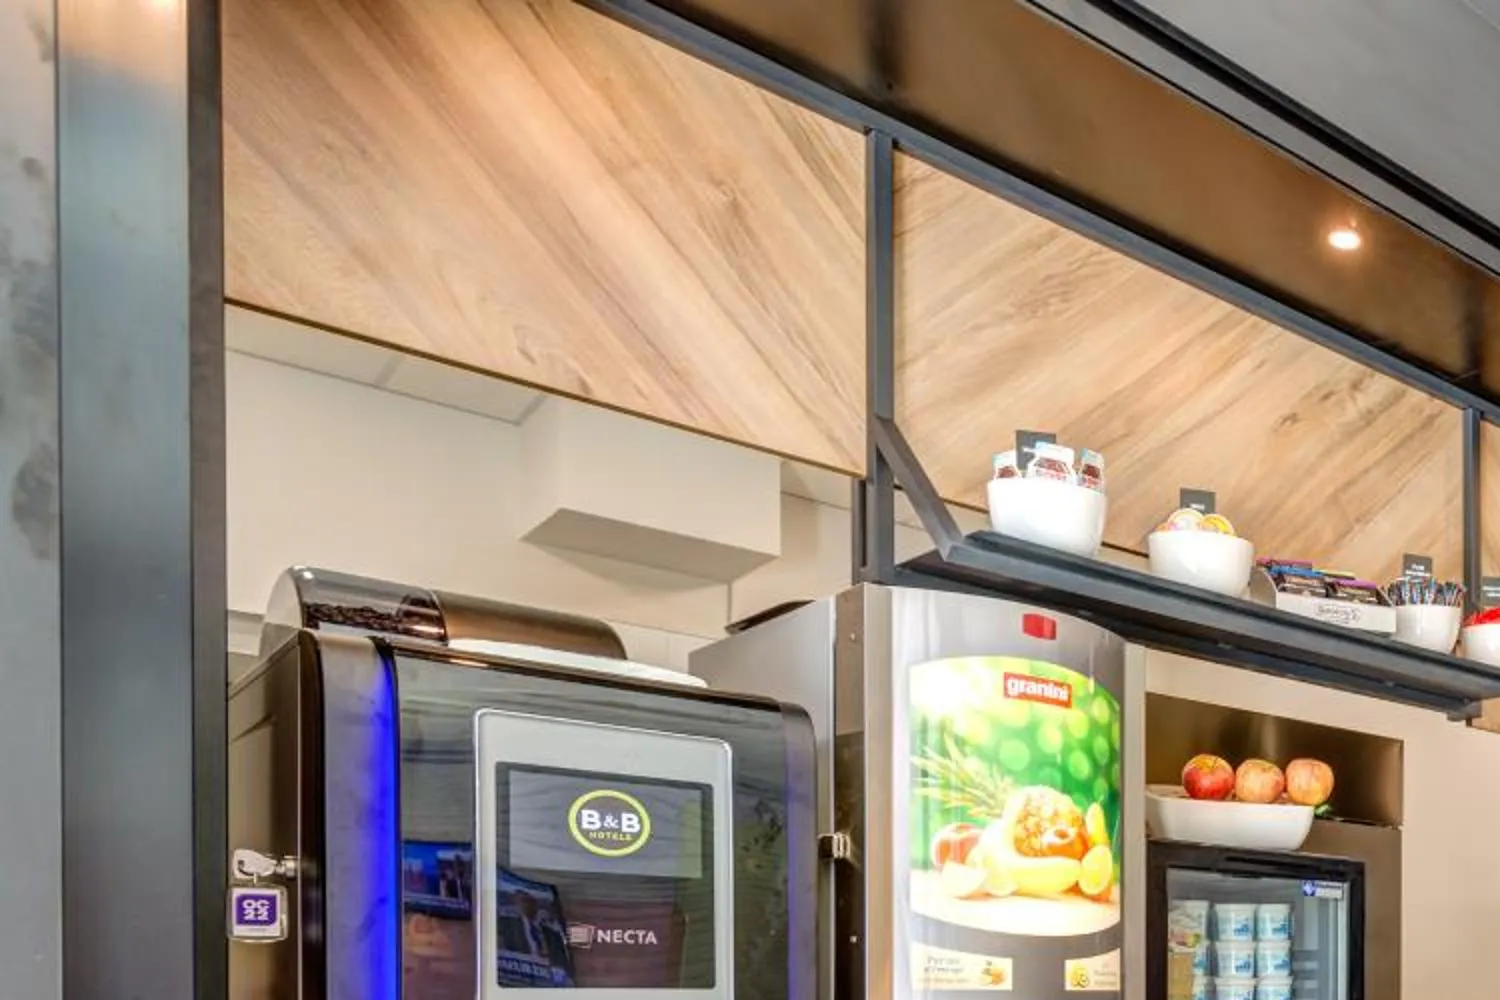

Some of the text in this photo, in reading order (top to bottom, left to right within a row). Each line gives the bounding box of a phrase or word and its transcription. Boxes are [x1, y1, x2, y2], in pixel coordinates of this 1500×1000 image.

[1007, 678, 1069, 701] granini
[589, 831, 632, 841] HOTELS
[597, 929, 658, 945] NECTA
